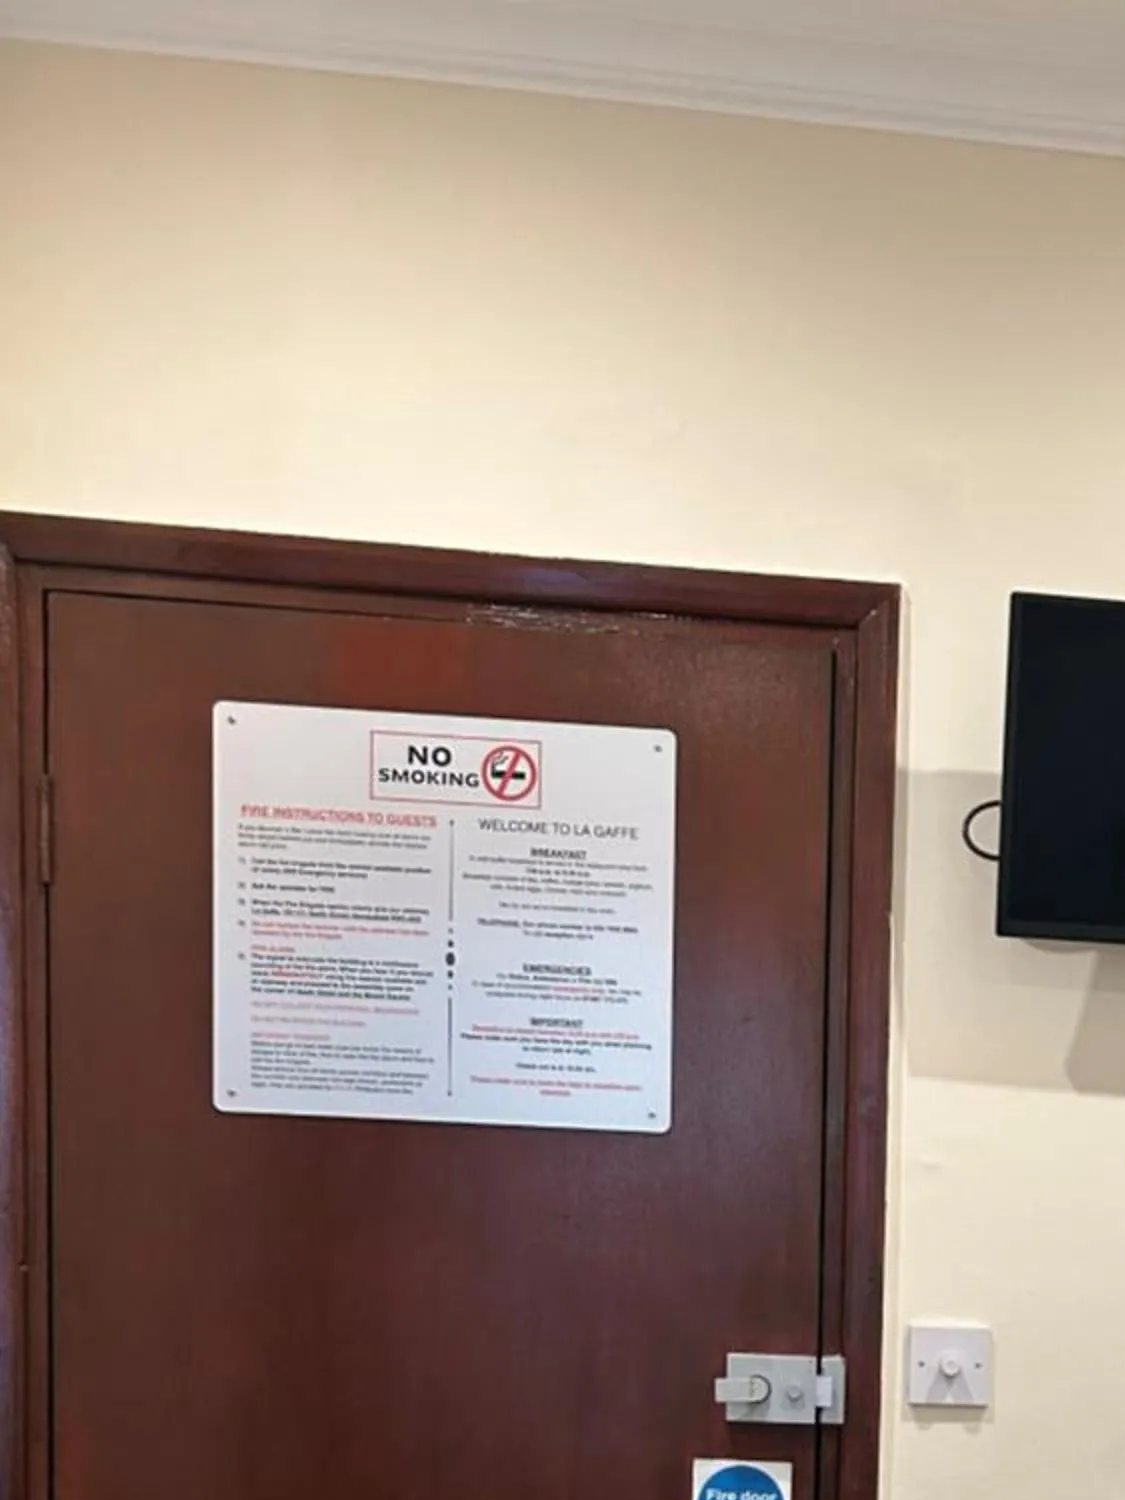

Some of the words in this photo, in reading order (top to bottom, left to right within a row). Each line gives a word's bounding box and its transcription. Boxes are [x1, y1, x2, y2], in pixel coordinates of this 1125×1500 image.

[408, 745, 452, 767] NO
[378, 768, 480, 788] SMOKING
[241, 805, 268, 819] FIRE
[273, 807, 364, 823] INSTRUCTIONS
[367, 812, 383, 824] TO
[387, 813, 437, 827] GUESTS
[478, 818, 547, 834] WELCOME
[553, 822, 570, 835] TO
[574, 824, 592, 837] LA
[593, 825, 640, 840] GAFFE
[530, 847, 588, 860] BREAKFAST
